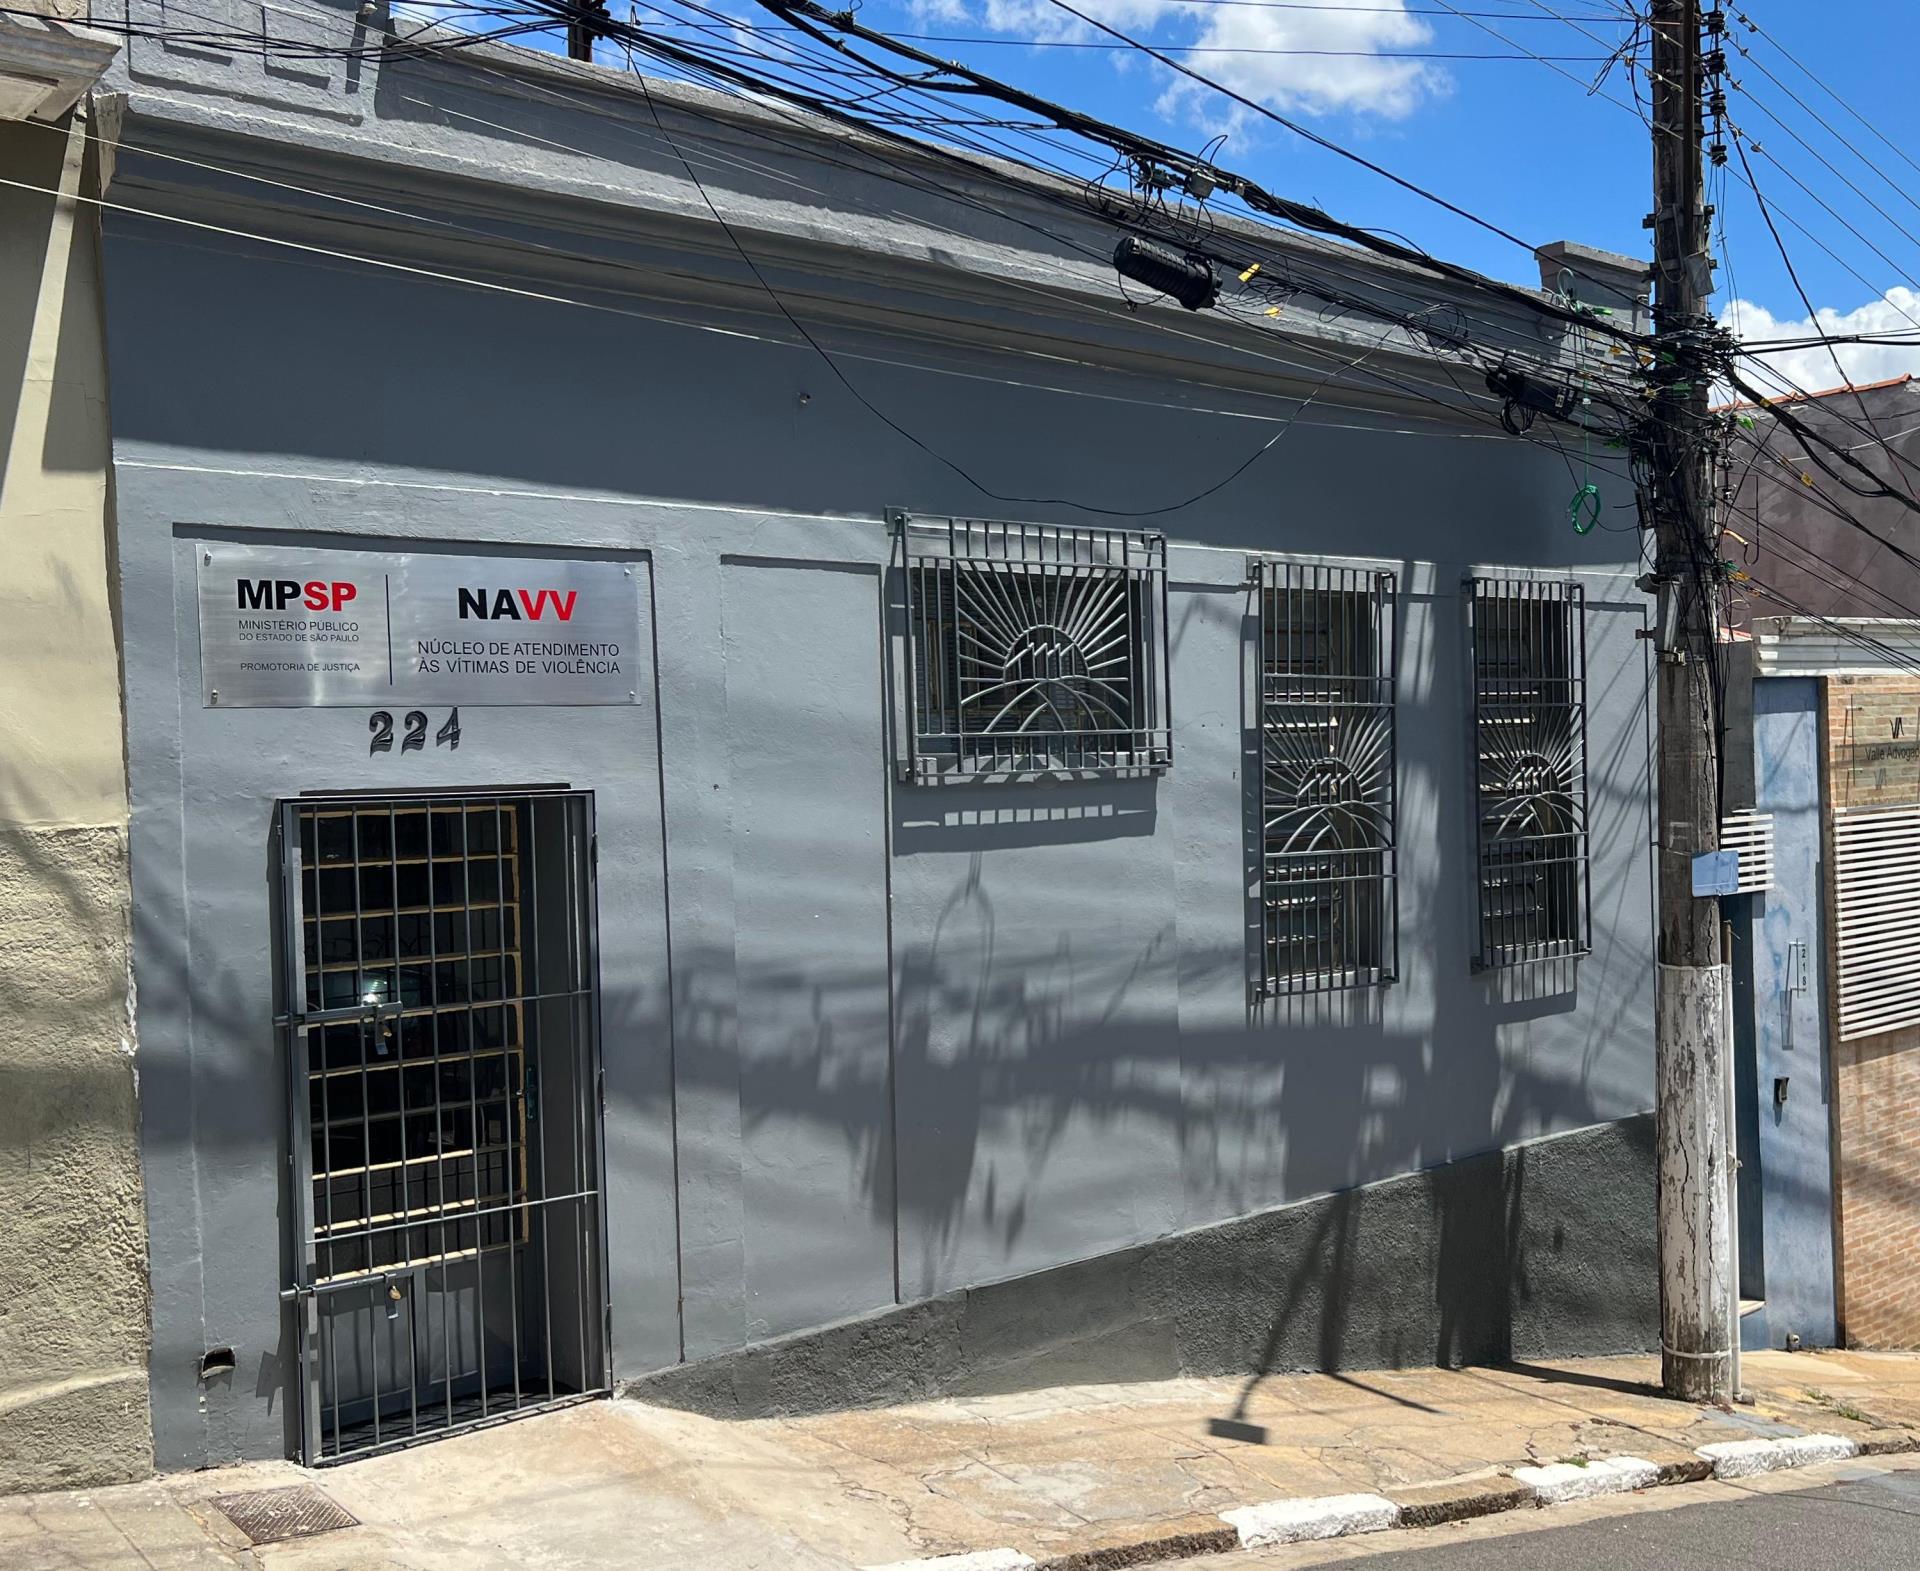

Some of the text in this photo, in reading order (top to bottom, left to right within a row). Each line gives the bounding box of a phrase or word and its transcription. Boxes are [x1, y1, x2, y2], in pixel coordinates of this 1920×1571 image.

[237, 579, 357, 611] MPSP
[458, 587, 578, 621] NAVV
[238, 620, 359, 632] MINISTÉRIO PÚBLICO
[239, 633, 359, 642] DO ESTADO DE SÃO PAULO
[418, 638, 620, 656] NÚCLEO DE ATENDIMENTO
[240, 662, 360, 673] PROMOTORIA DE JUSTIÇA
[418, 656, 621, 674] ÀS VÍTIMAS DE VIOLÊNCIA
[369, 706, 462, 758] 224
